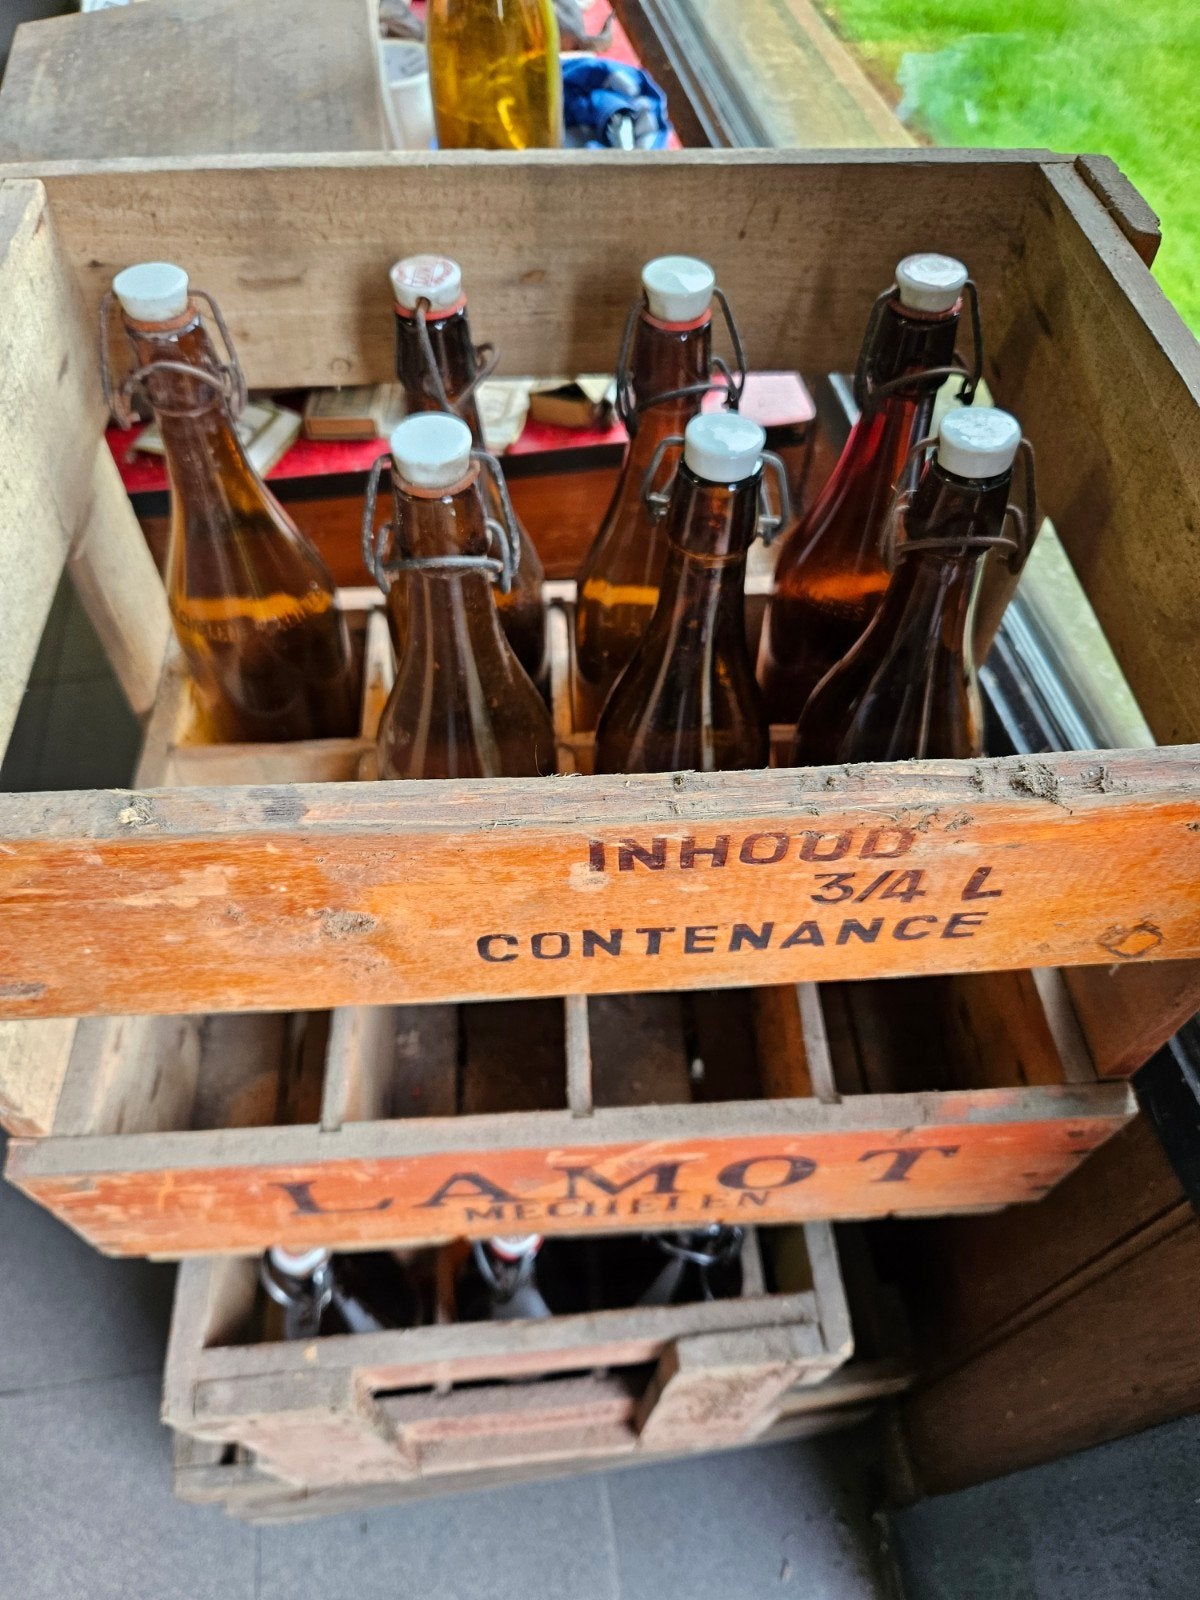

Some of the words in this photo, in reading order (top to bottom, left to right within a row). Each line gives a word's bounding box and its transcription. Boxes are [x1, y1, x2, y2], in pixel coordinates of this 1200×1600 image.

[588, 828, 917, 872] INHOUD
[811, 869, 927, 904] 3/4
[961, 866, 1003, 901] L
[476, 911, 989, 963] CONTENANCE
[267, 1144, 961, 1216] LAMOT
[463, 1190, 771, 1223] MECHELEN
